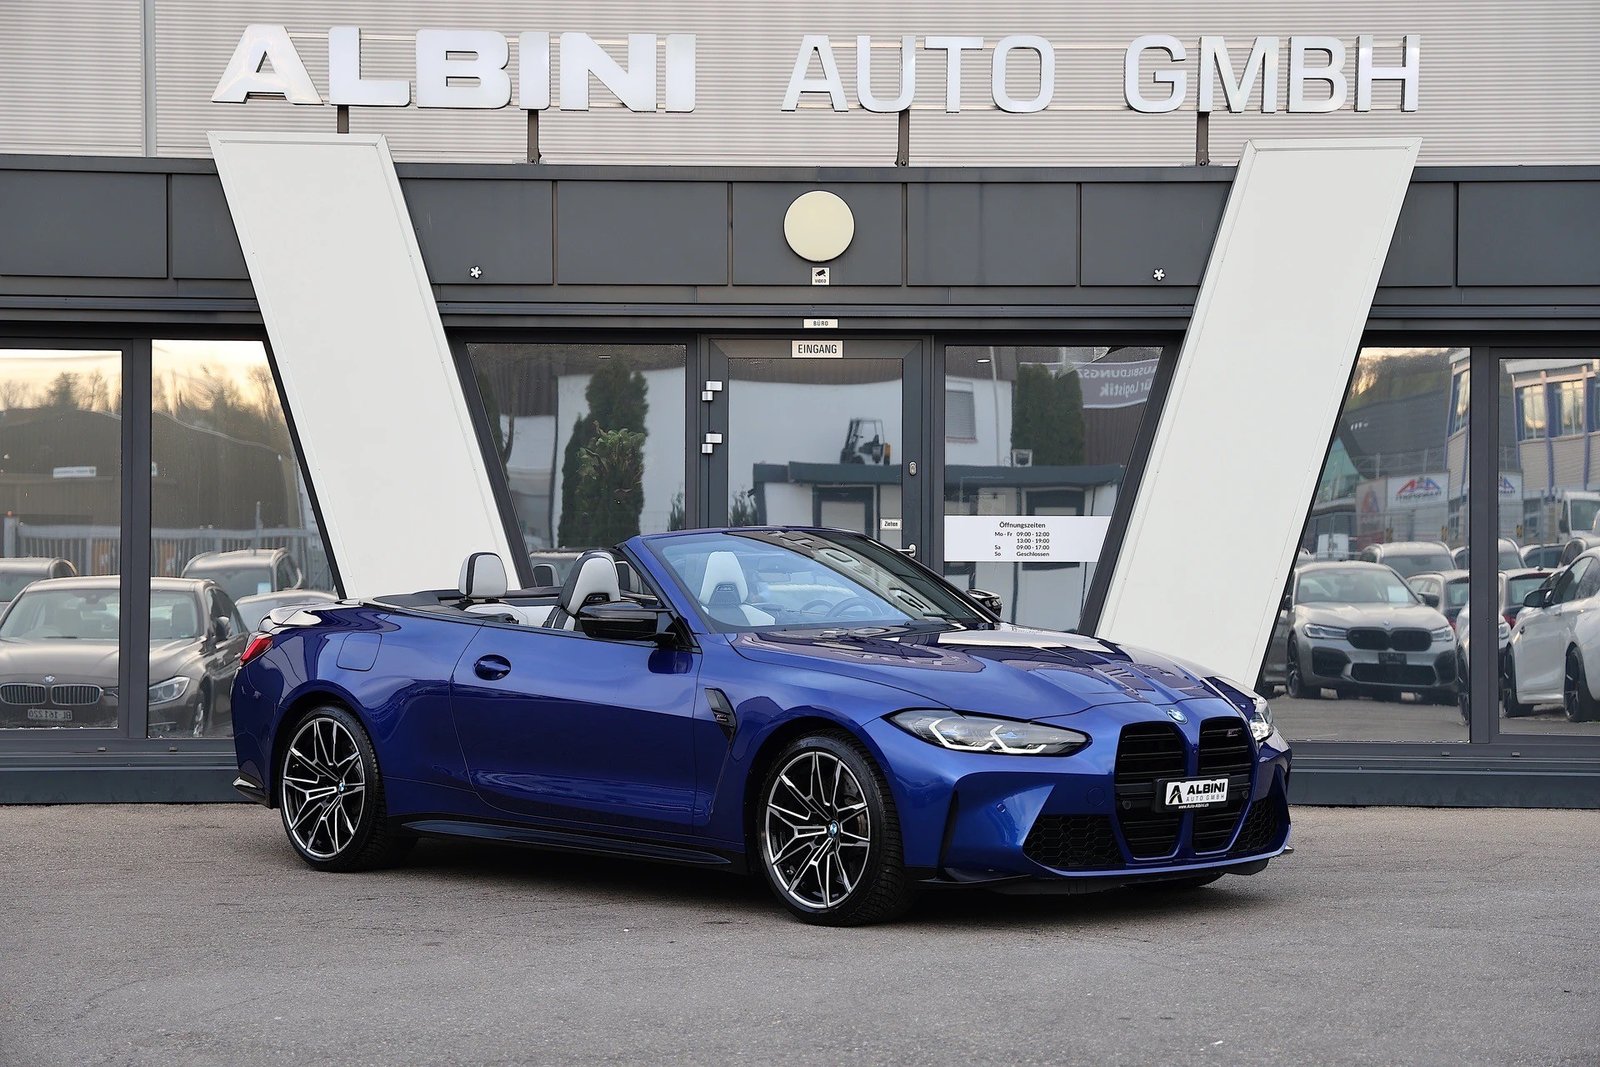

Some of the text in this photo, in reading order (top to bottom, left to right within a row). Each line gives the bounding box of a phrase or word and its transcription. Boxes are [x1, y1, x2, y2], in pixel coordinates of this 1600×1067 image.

[211, 23, 1421, 115] ALBINI AUTO GMBH
[798, 344, 837, 354] EINGANG
[999, 521, 1046, 529] Öffnungszeiten
[1187, 782, 1225, 795] ALBINI
[1205, 793, 1225, 801] GMBH
